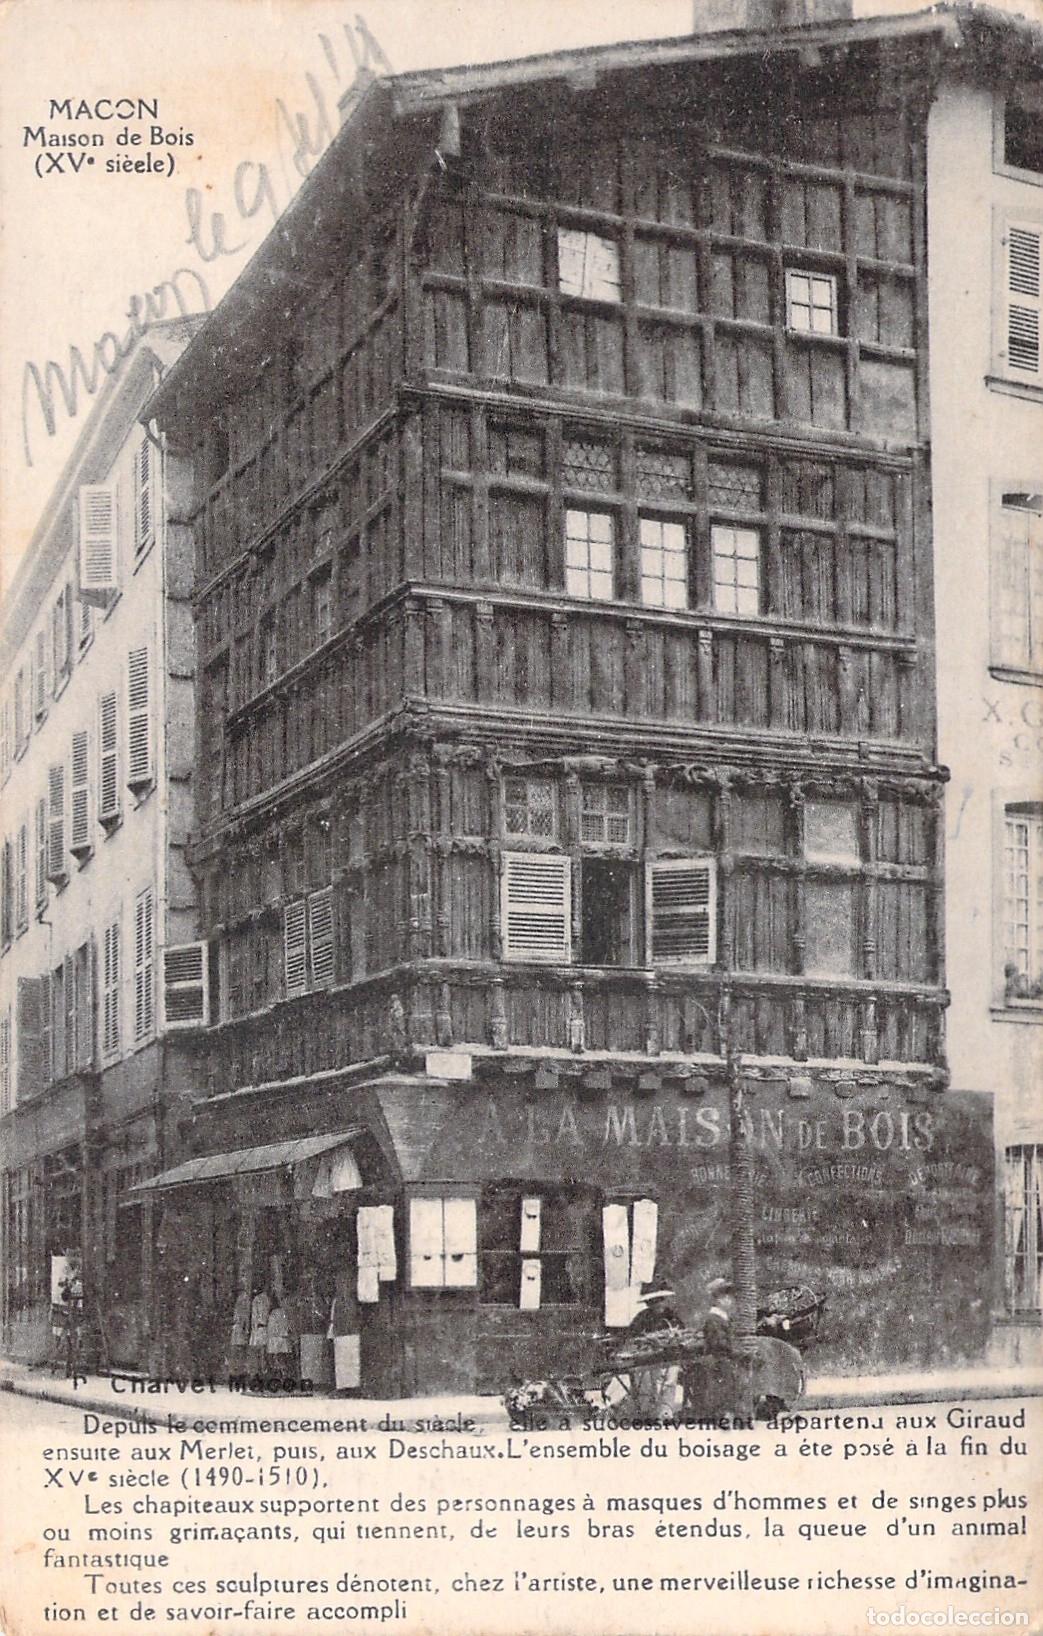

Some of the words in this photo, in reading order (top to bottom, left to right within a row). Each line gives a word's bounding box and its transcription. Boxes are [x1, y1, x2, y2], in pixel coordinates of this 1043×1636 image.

[513, 1104, 584, 1147] LA
[799, 1120, 827, 1150] DE
[841, 1109, 934, 1151] BOIS
